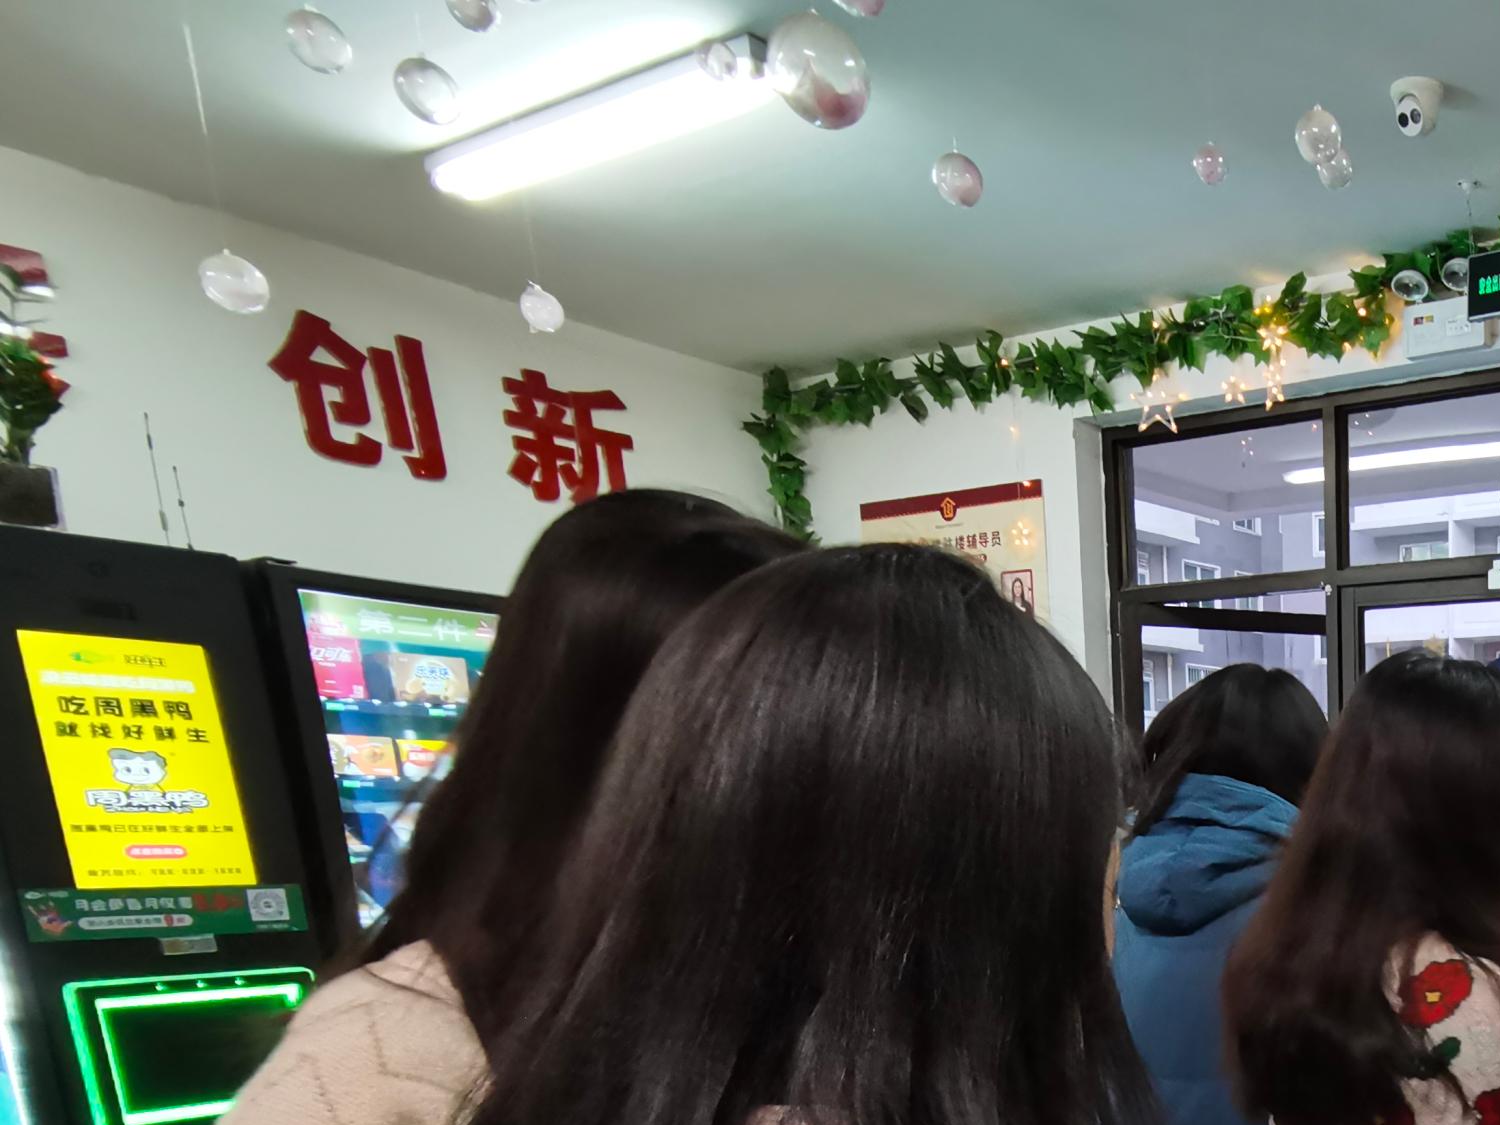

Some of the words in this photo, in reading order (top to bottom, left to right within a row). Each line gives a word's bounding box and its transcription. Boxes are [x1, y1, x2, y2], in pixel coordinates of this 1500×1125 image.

[267, 309, 634, 506] 创新
[57, 696, 193, 720] 吃周黑鸭
[54, 721, 210, 743] 就找好鲜生
[85, 789, 210, 809] 周黑鸭
